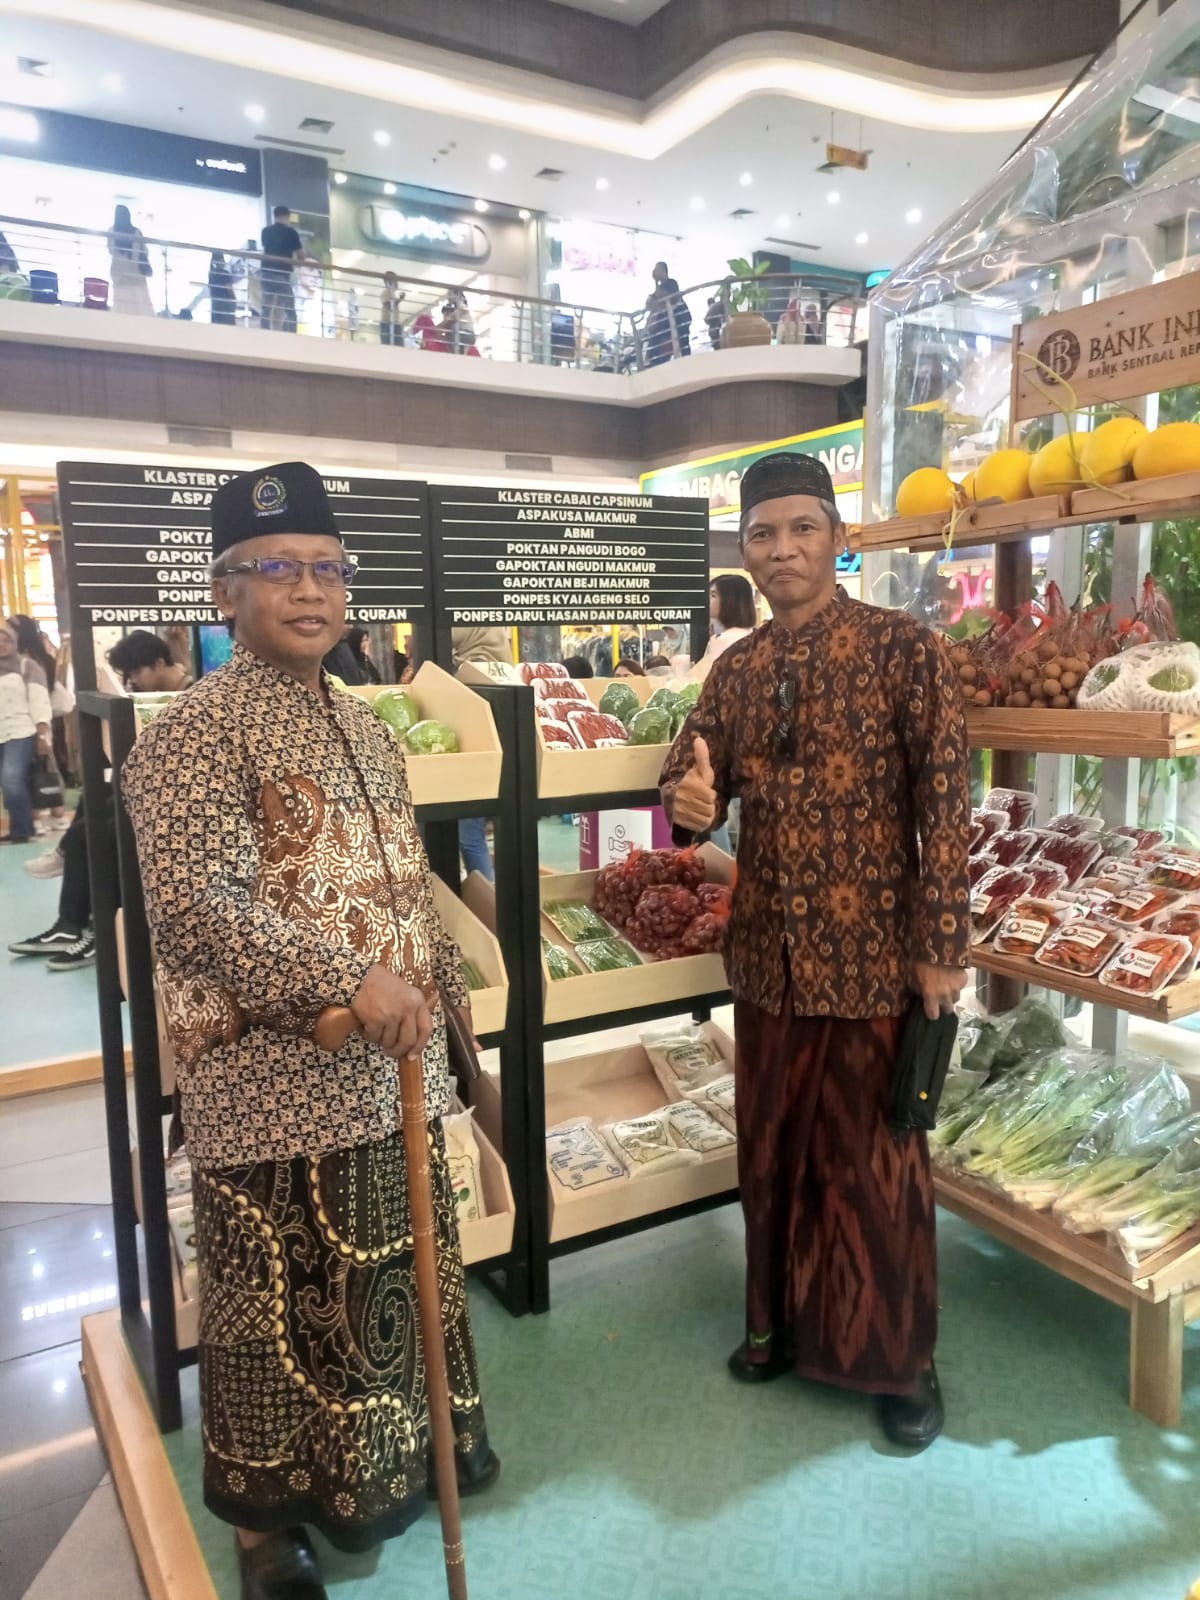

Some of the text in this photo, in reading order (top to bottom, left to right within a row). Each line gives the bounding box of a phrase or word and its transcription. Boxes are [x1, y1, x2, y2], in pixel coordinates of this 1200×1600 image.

[1088, 322, 1155, 362] BANK
[1087, 363, 1118, 379] BANK
[1122, 349, 1176, 372] SENTRAL
[144, 470, 216, 486] KLASTER
[498, 490, 653, 508] KLASTER CABAI CAPSINUM
[517, 509, 637, 524] ASPAKUSA MAKMUR
[564, 528, 594, 539] ABMI
[506, 543, 646, 556] POKTAN PANGUDI BOGO
[496, 560, 656, 573] GAPOKTAN NGUDI MAKMUR
[502, 577, 650, 589] GAPOKTAN BEJI MAKMUR
[503, 594, 650, 604] PONPES KYAI AGENG SELO
[92, 609, 159, 622] PONPES
[162, 609, 216, 622] DARUL
[358, 608, 407, 621] QURAN
[454, 609, 691, 622] PONPES DARUL HASAN DAN DARUL QURAN
